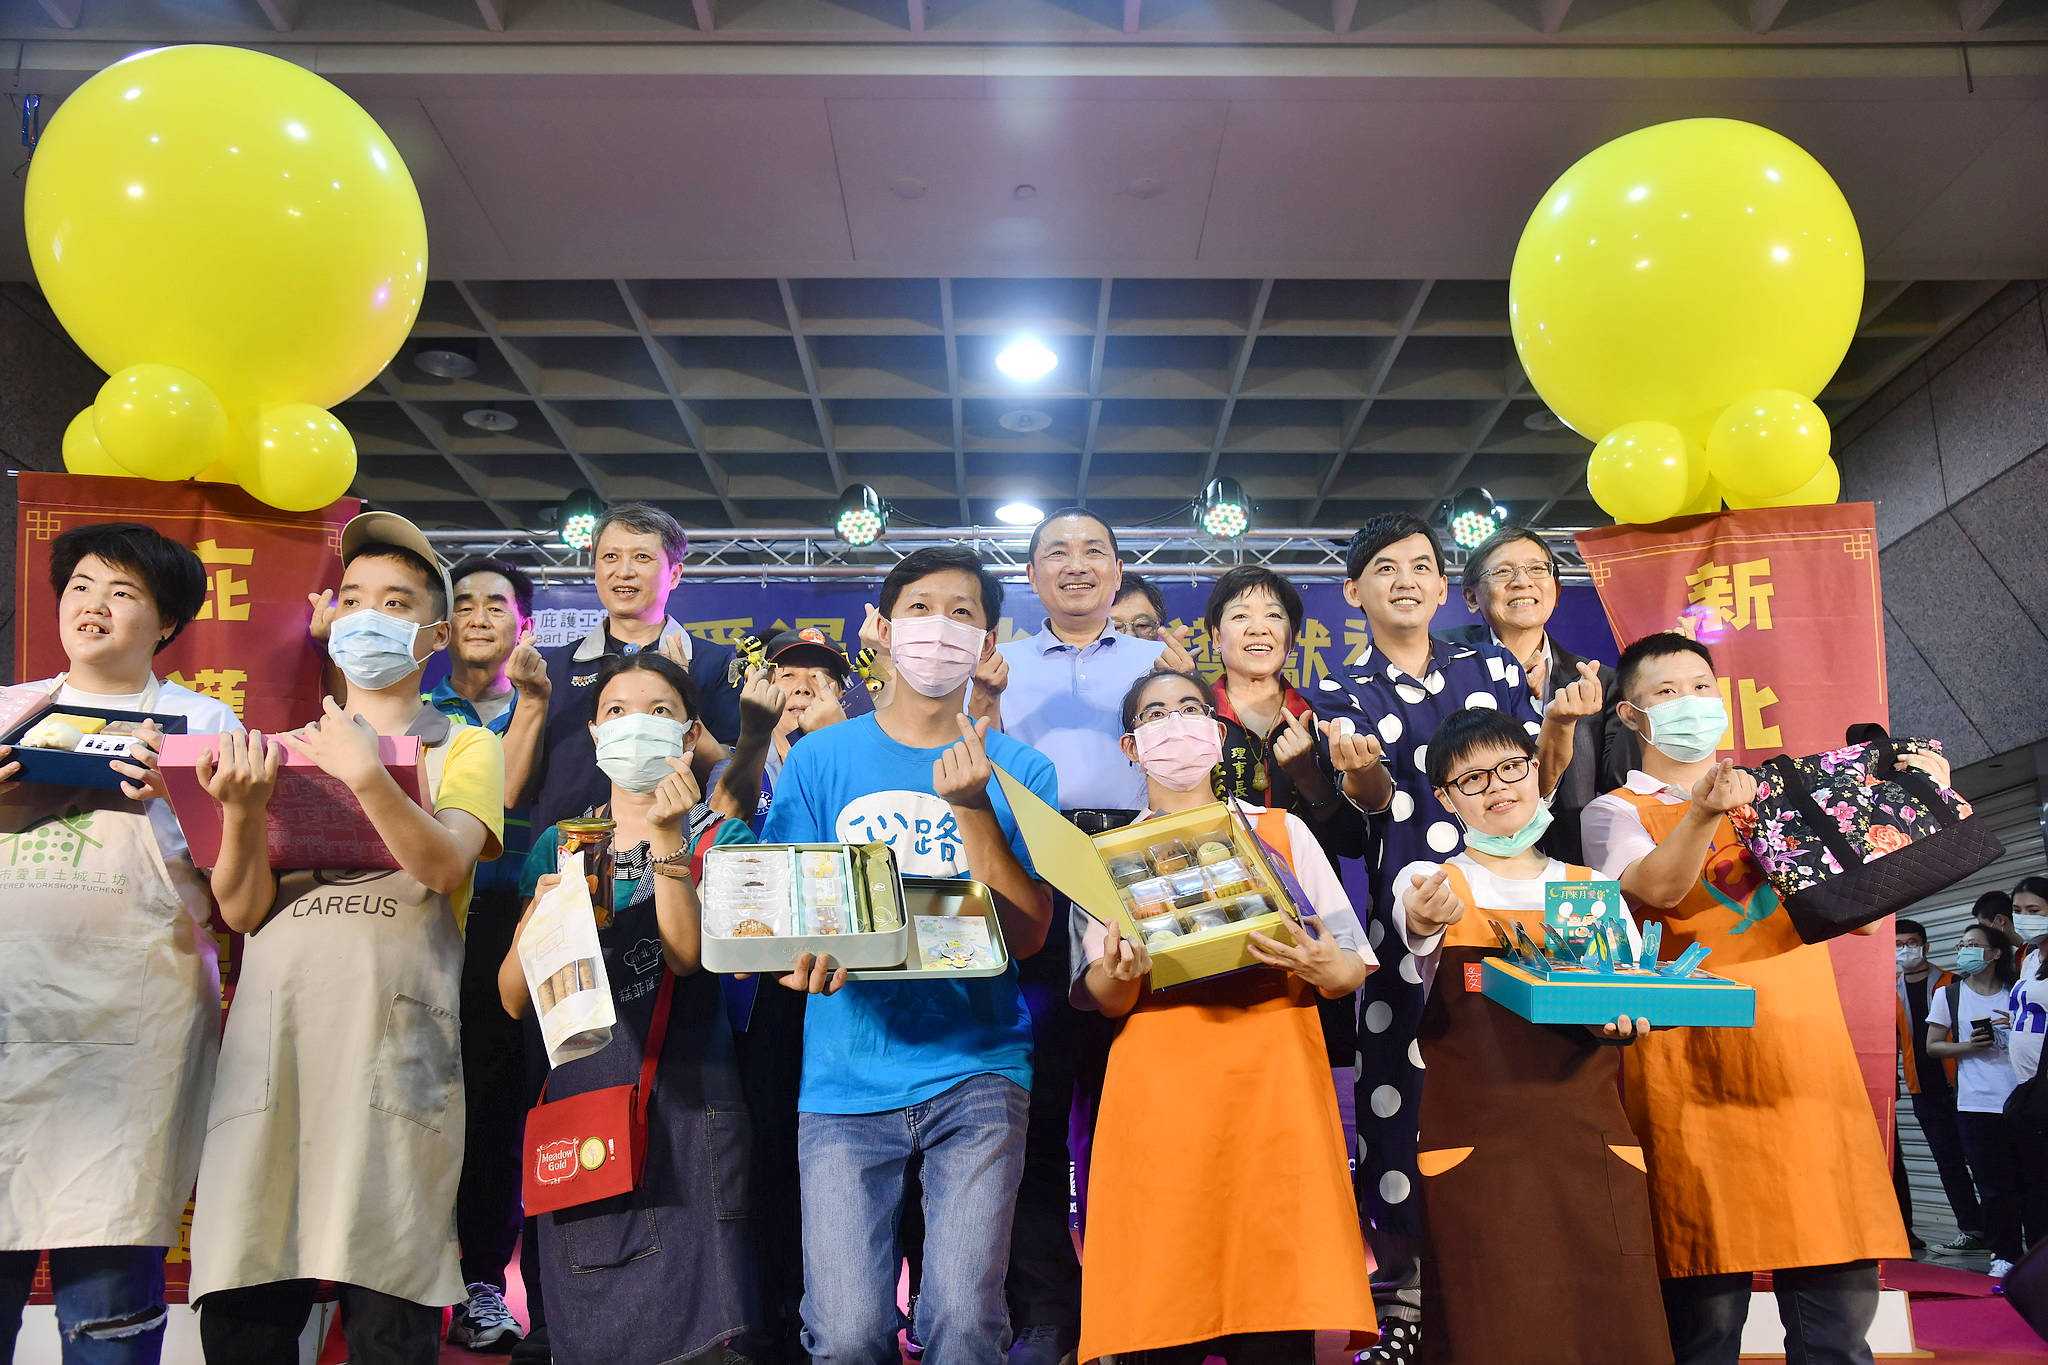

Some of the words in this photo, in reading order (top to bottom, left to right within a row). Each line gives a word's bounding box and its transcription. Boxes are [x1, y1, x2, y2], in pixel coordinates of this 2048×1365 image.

[533, 611, 607, 628] 庇護工
[535, 632, 561, 643] eart
[1231, 747, 1248, 797] 理事長
[28, 882, 79, 891] WORKSHOP
[82, 884, 124, 895] TUCHENG
[292, 895, 398, 917] CAREUS
[541, 1149, 573, 1162] Meadow
[548, 1160, 567, 1171] Gold
